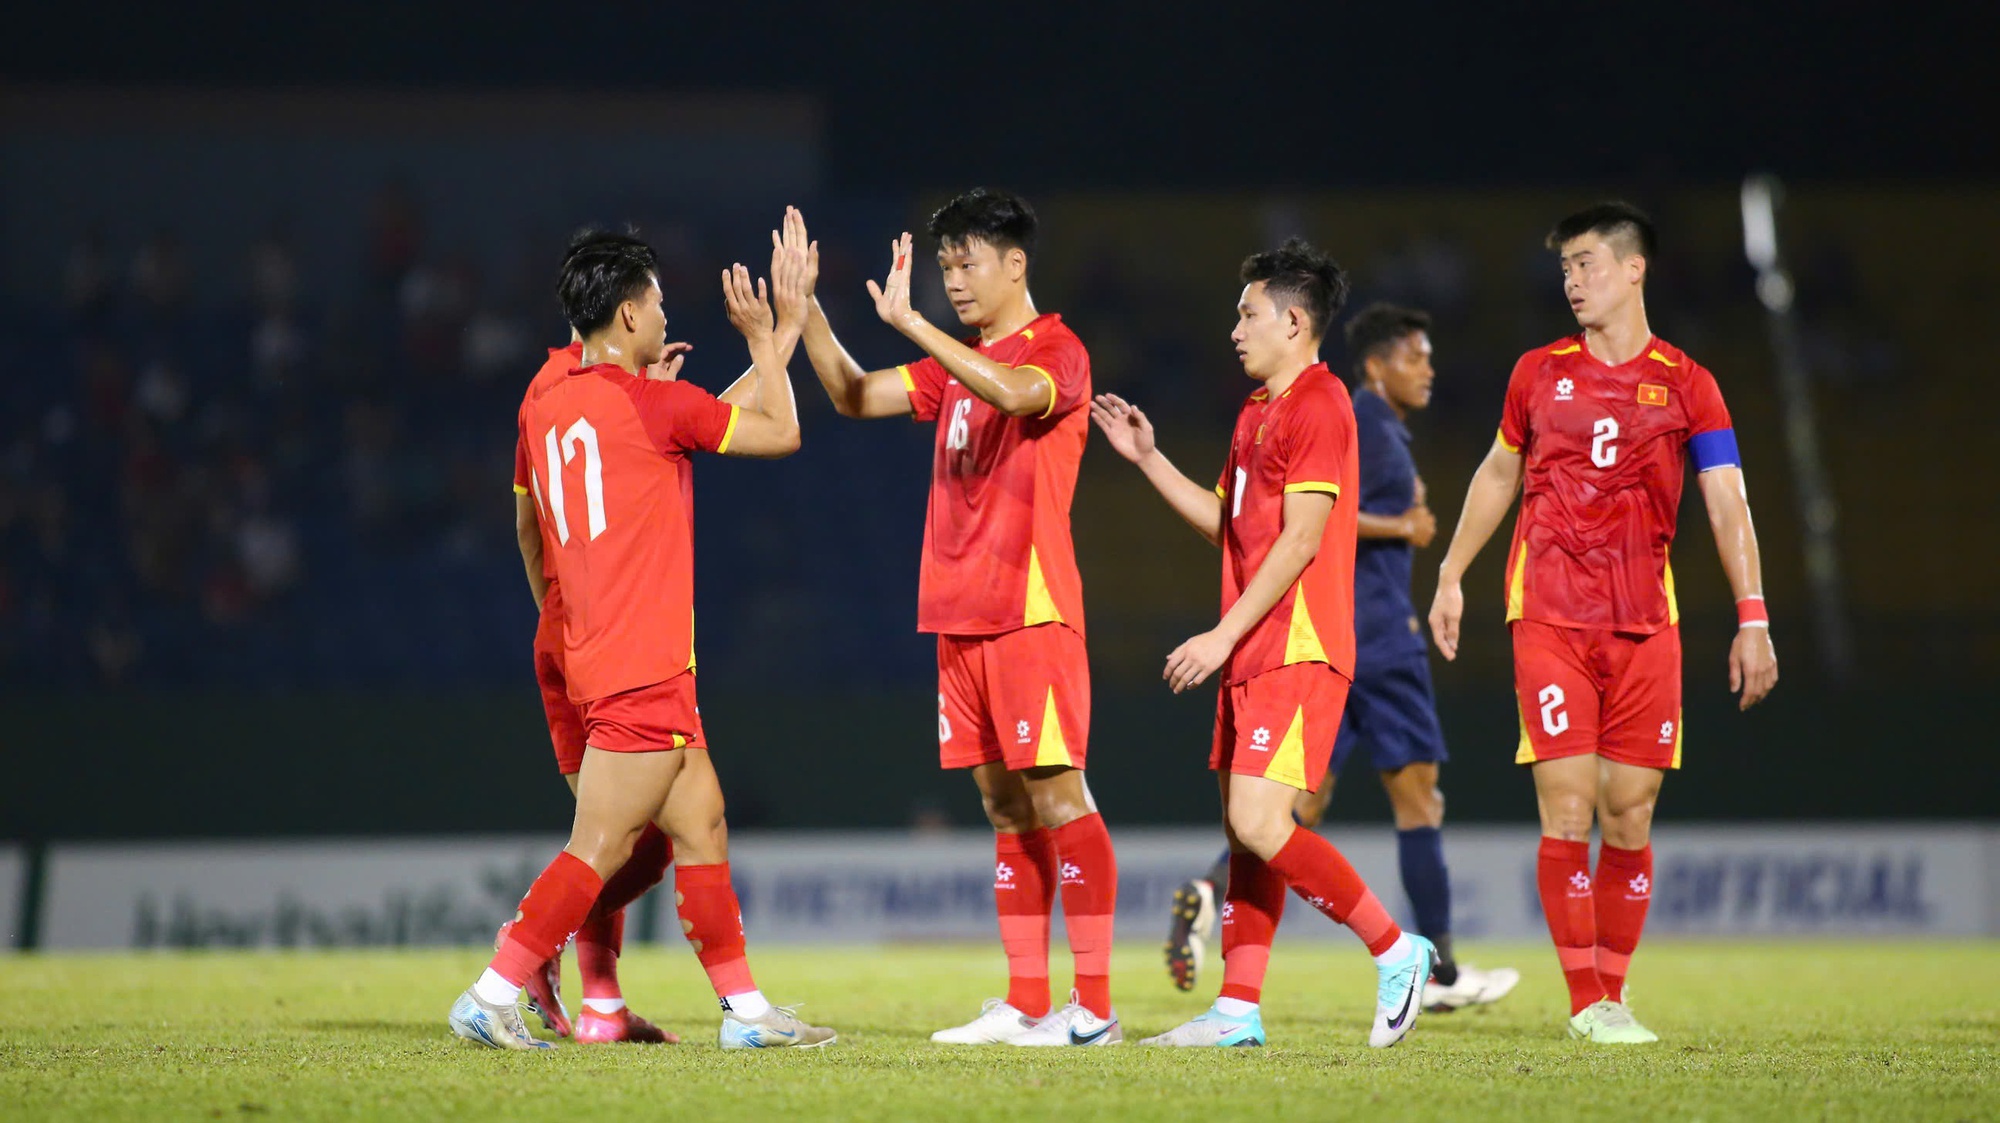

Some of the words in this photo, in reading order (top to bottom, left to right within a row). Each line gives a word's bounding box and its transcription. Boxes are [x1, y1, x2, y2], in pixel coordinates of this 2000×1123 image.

[945, 398, 971, 450] 16
[1590, 416, 1619, 468] 2
[545, 416, 607, 548] 17
[1538, 683, 1569, 737] 2
